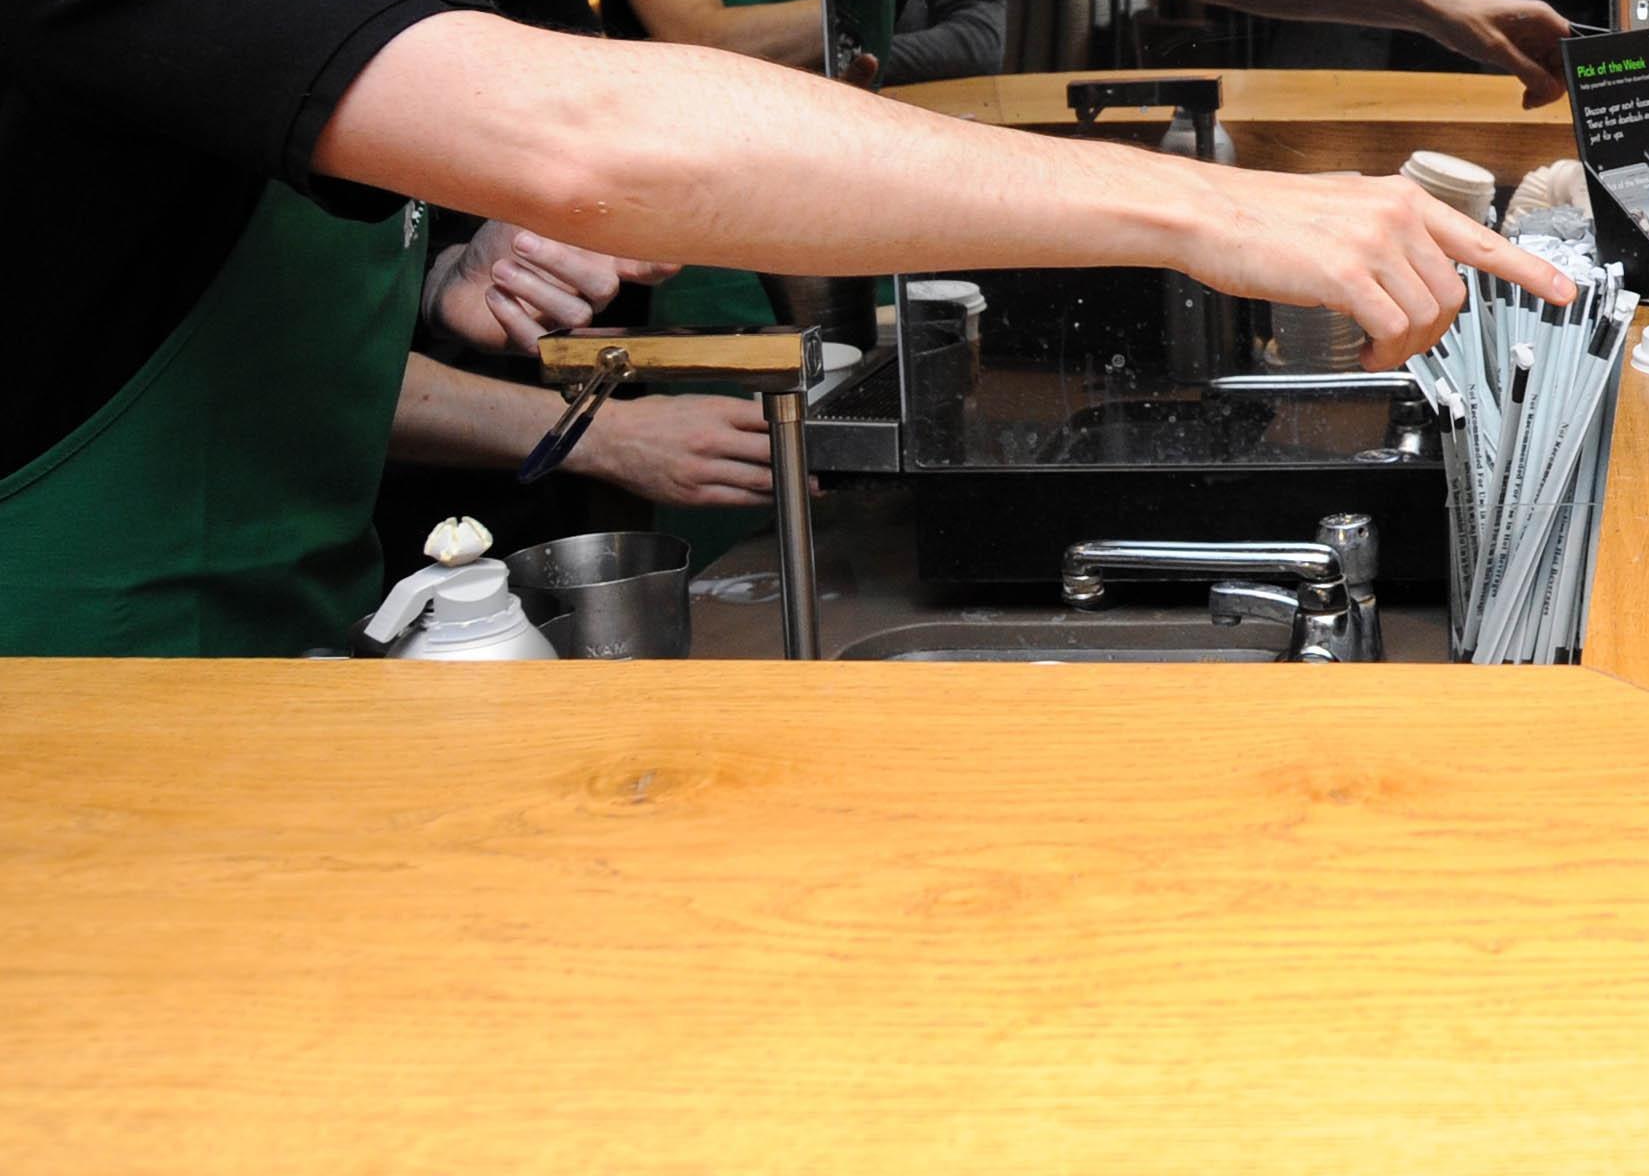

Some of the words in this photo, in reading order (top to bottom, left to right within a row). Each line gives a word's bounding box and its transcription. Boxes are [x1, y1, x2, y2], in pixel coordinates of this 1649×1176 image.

[1577, 64, 1595, 78] Pick
[1597, 62, 1606, 75] of
[1608, 60, 1622, 73] the
[1623, 57, 1646, 70] Week
[1468, 383, 1476, 400] Not
[1529, 393, 1538, 410] Not
[1470, 403, 1482, 469] Recommended
[1515, 412, 1534, 479] Recommended
[1476, 472, 1484, 487] For
[1511, 481, 1519, 498] For
[1500, 533, 1509, 550] Hot
[1552, 547, 1561, 565] Hot
[1489, 552, 1505, 598] Beverages
[1542, 567, 1557, 616] Beverages
